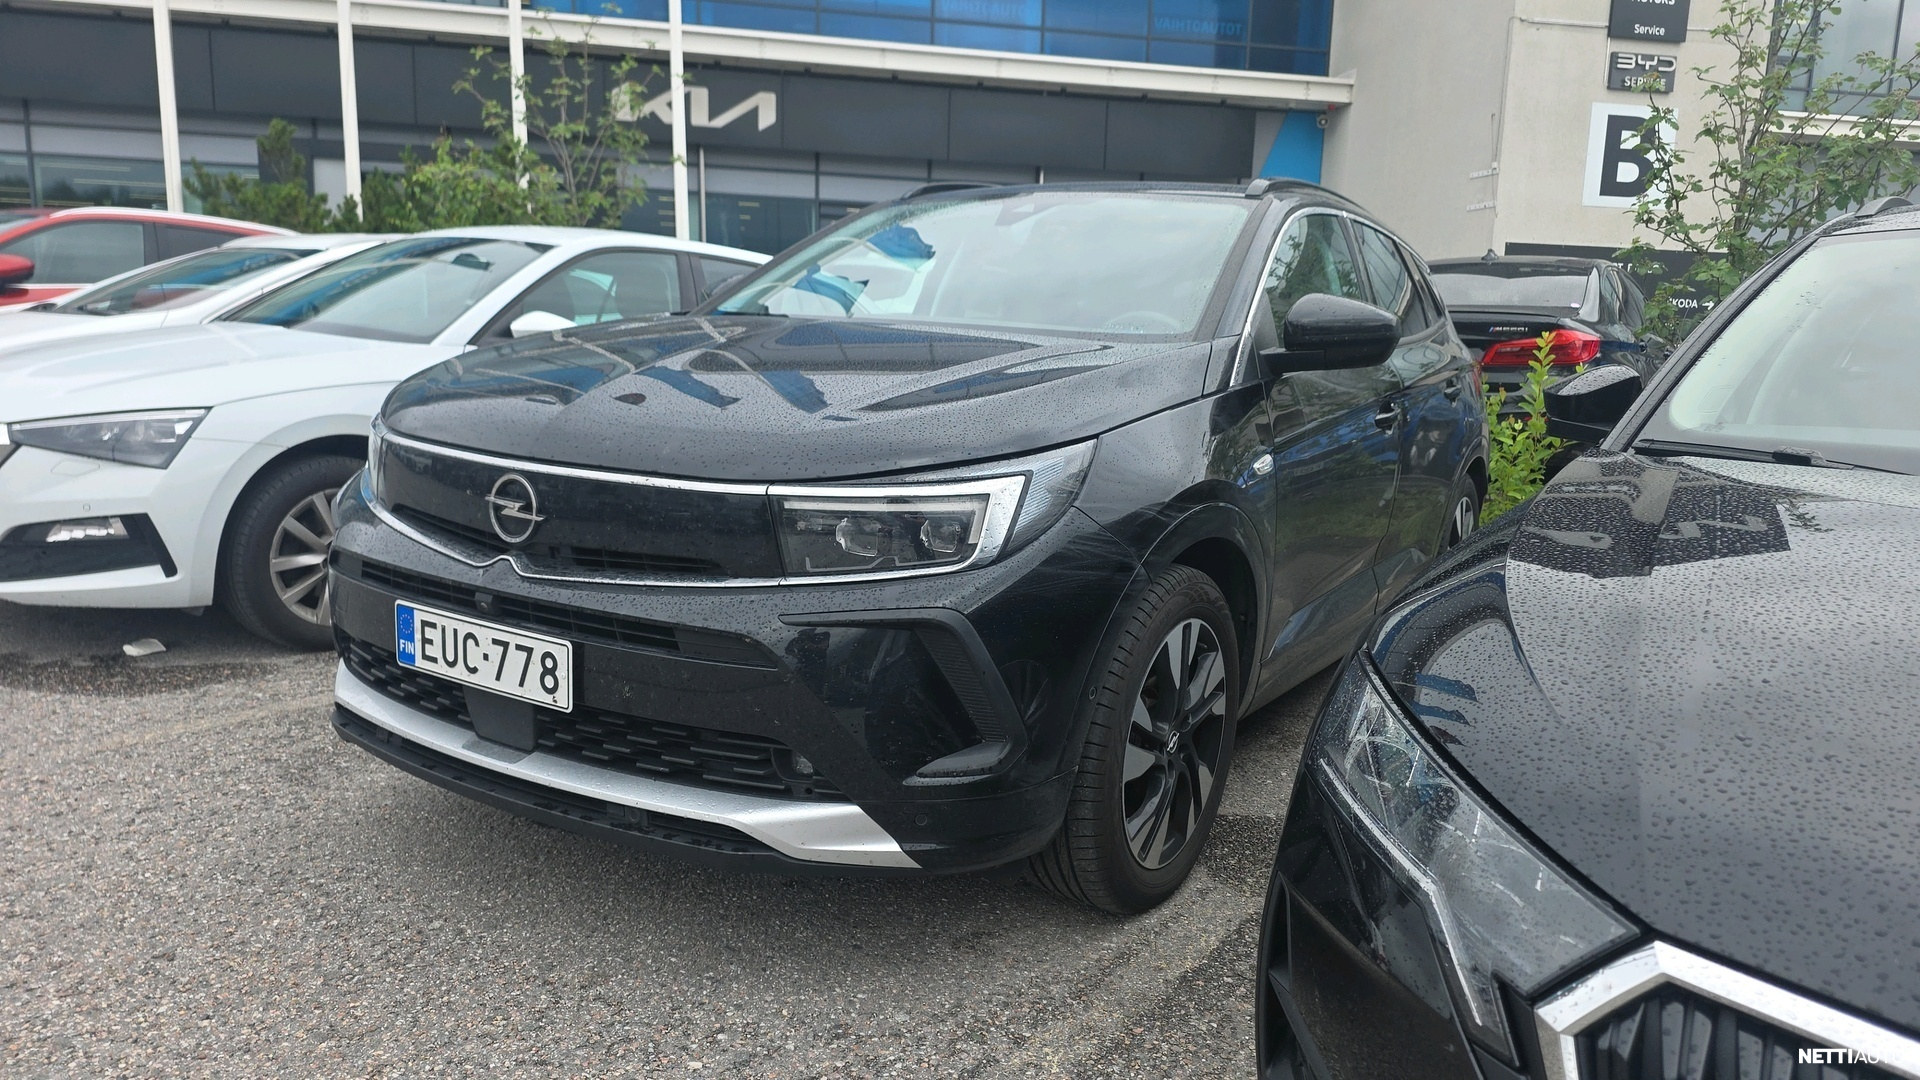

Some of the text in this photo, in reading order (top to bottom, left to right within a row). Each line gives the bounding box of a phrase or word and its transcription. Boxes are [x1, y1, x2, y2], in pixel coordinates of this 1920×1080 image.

[1634, 23, 1665, 36] Service
[1616, 53, 1676, 72] BYD
[1624, 75, 1667, 88] SERE
[1599, 114, 1659, 198] B
[1668, 296, 1698, 309] KODA
[400, 639, 415, 655] FIN
[420, 619, 559, 695] EUC-778
